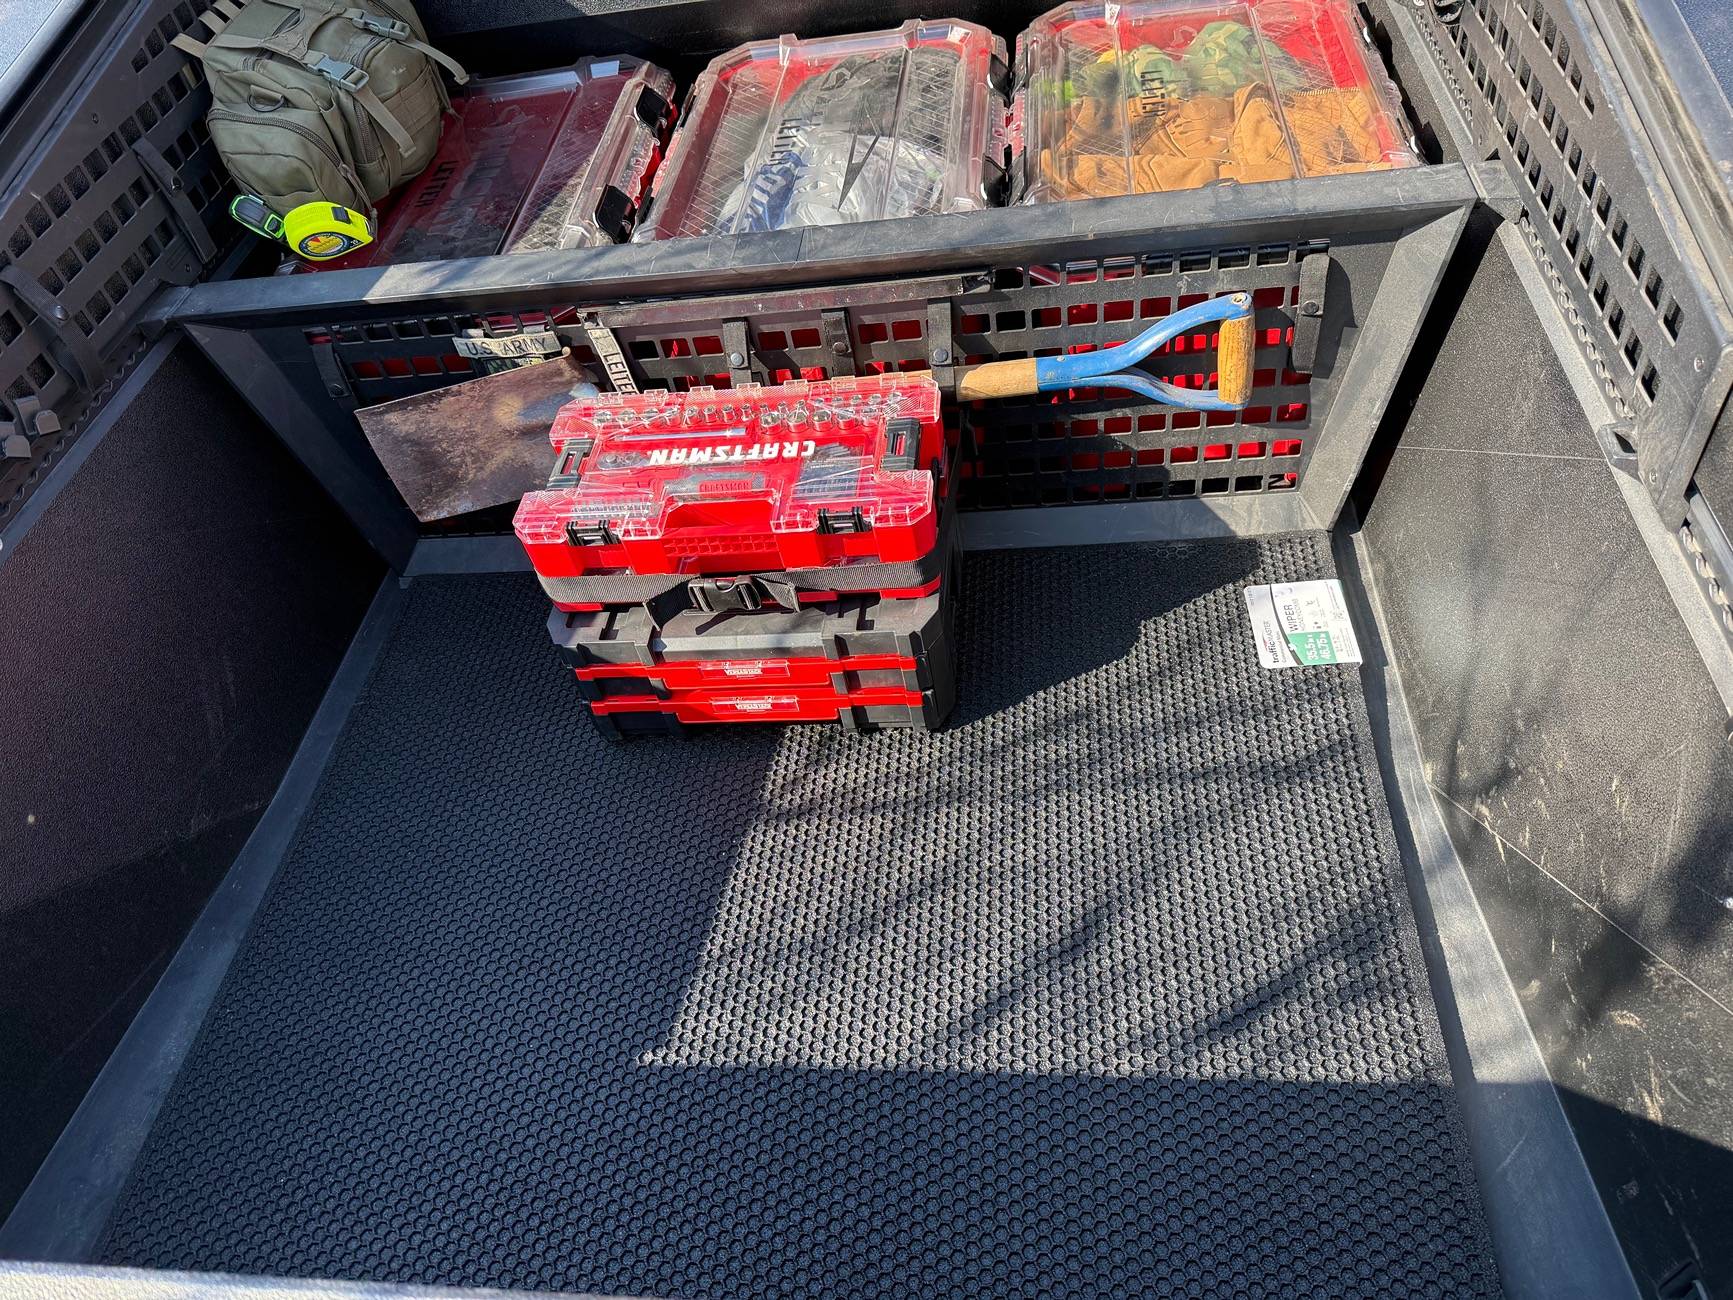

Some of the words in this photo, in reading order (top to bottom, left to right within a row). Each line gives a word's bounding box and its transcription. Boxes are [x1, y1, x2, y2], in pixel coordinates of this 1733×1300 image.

[501, 338, 546, 356] ARMY
[602, 352, 638, 394] LEITE
[649, 441, 815, 465] CRAFTSMAN
[1284, 604, 1298, 632] WIPER
